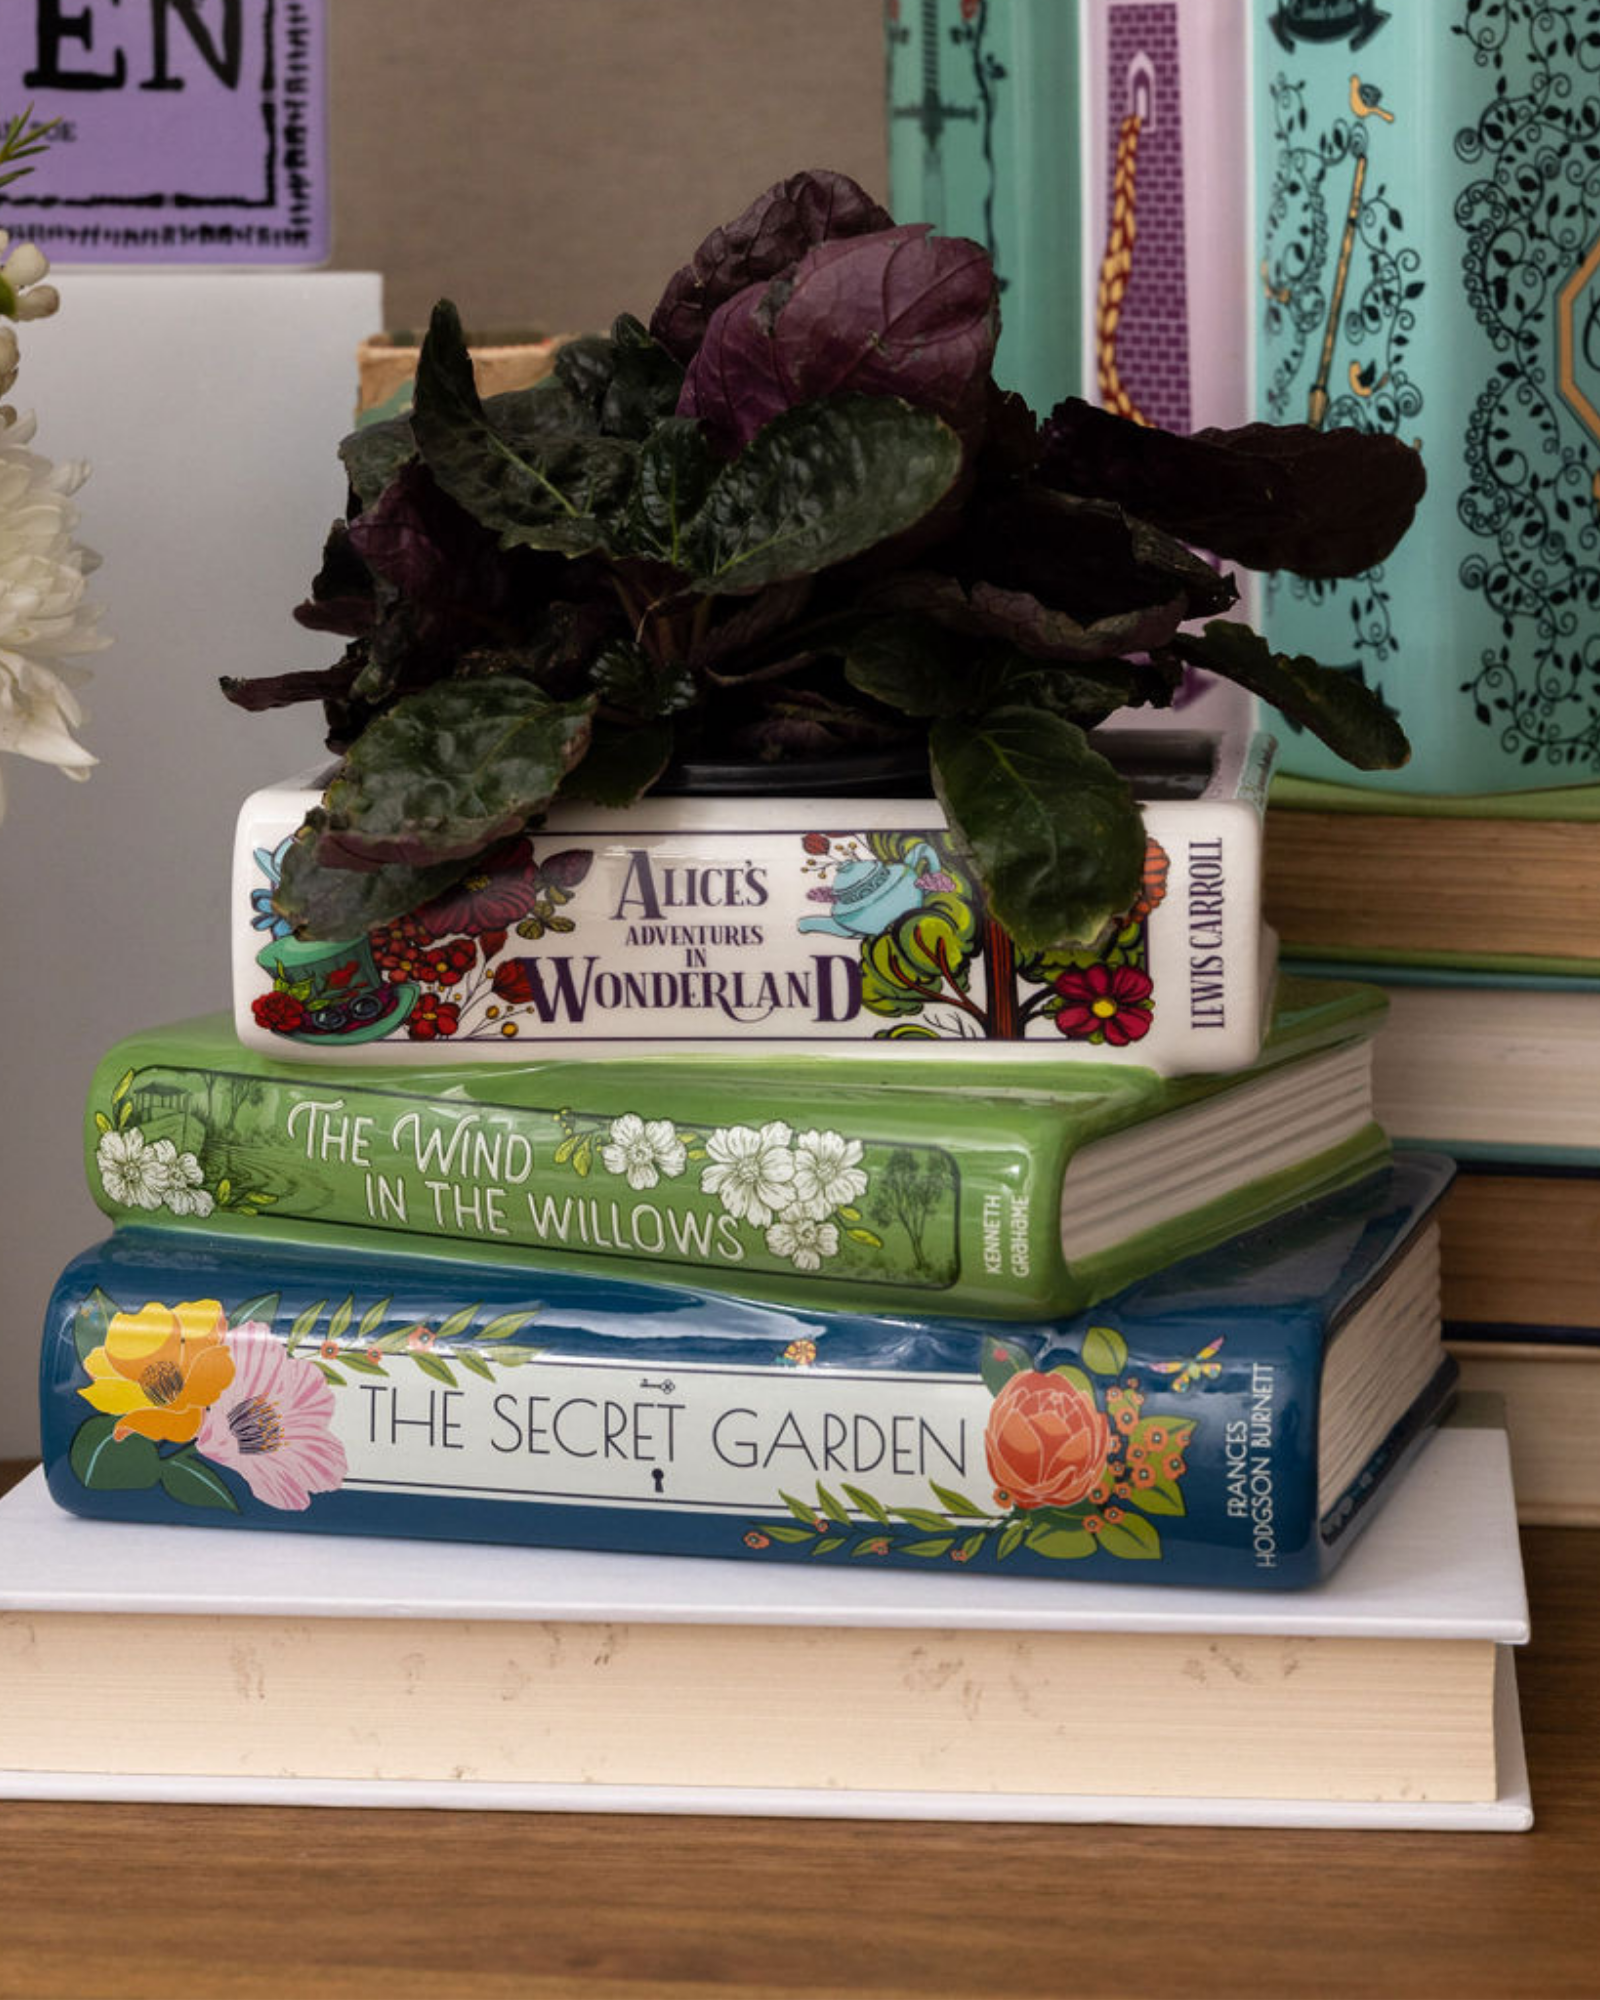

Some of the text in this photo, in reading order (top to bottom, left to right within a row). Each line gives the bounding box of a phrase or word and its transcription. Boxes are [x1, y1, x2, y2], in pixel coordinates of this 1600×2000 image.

[609, 849, 769, 920] ALICE'S
[625, 925, 764, 947] ADVENTURES
[685, 948, 707, 968] IN
[1188, 837, 1226, 1030] LEWIS CARROLL
[518, 954, 863, 1024] WONDERLAND
[287, 1099, 533, 1184] THE WIND
[364, 1173, 745, 1261] IN THE WILLOWS
[984, 1194, 1002, 1274] KENNETH
[359, 1384, 967, 1478] THE SECRET GARDEN
[1225, 1420, 1248, 1518] FRANCES
[1250, 1362, 1277, 1567] HODGSON BURNETT
